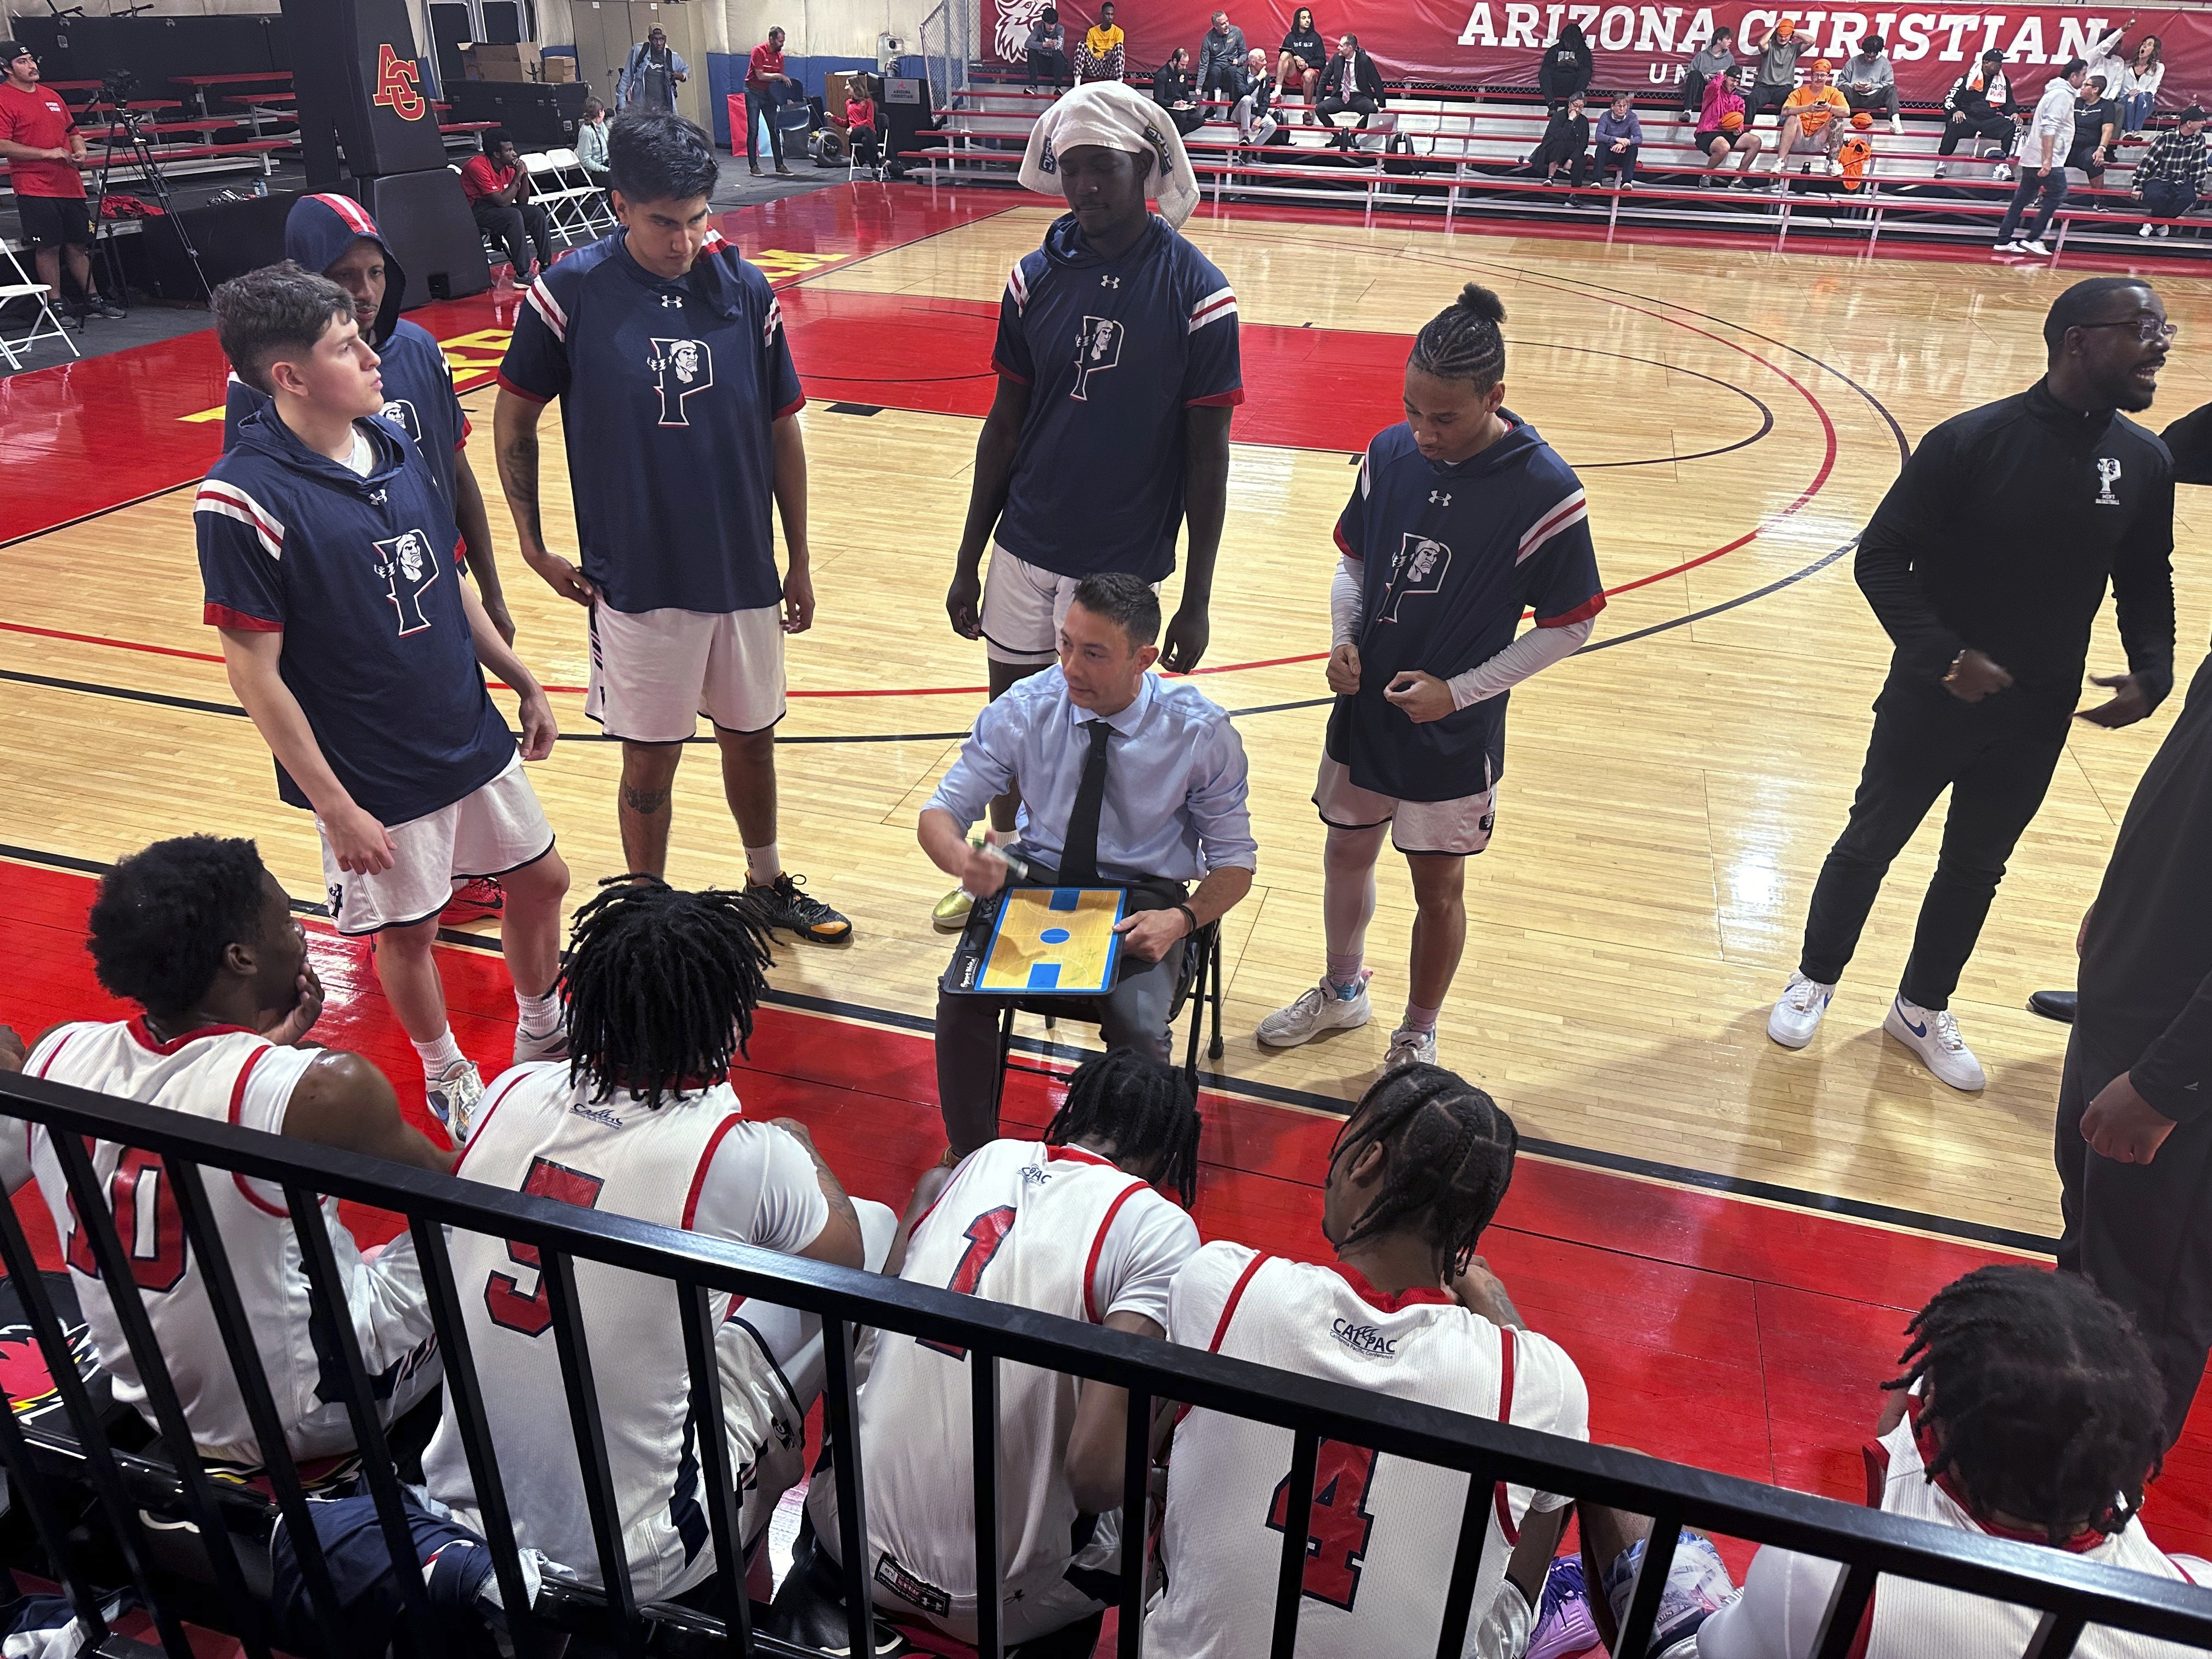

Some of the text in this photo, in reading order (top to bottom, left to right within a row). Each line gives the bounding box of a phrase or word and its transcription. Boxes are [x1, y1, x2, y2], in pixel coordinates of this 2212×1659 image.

[1457, 2, 2109, 65] ARIZONA CHRISTIAN
[915, 1204, 1018, 1362] 1
[1330, 1331, 1350, 1347] California
[1365, 1350, 1393, 1359] Conference
[1265, 1435, 1375, 1613] 4
